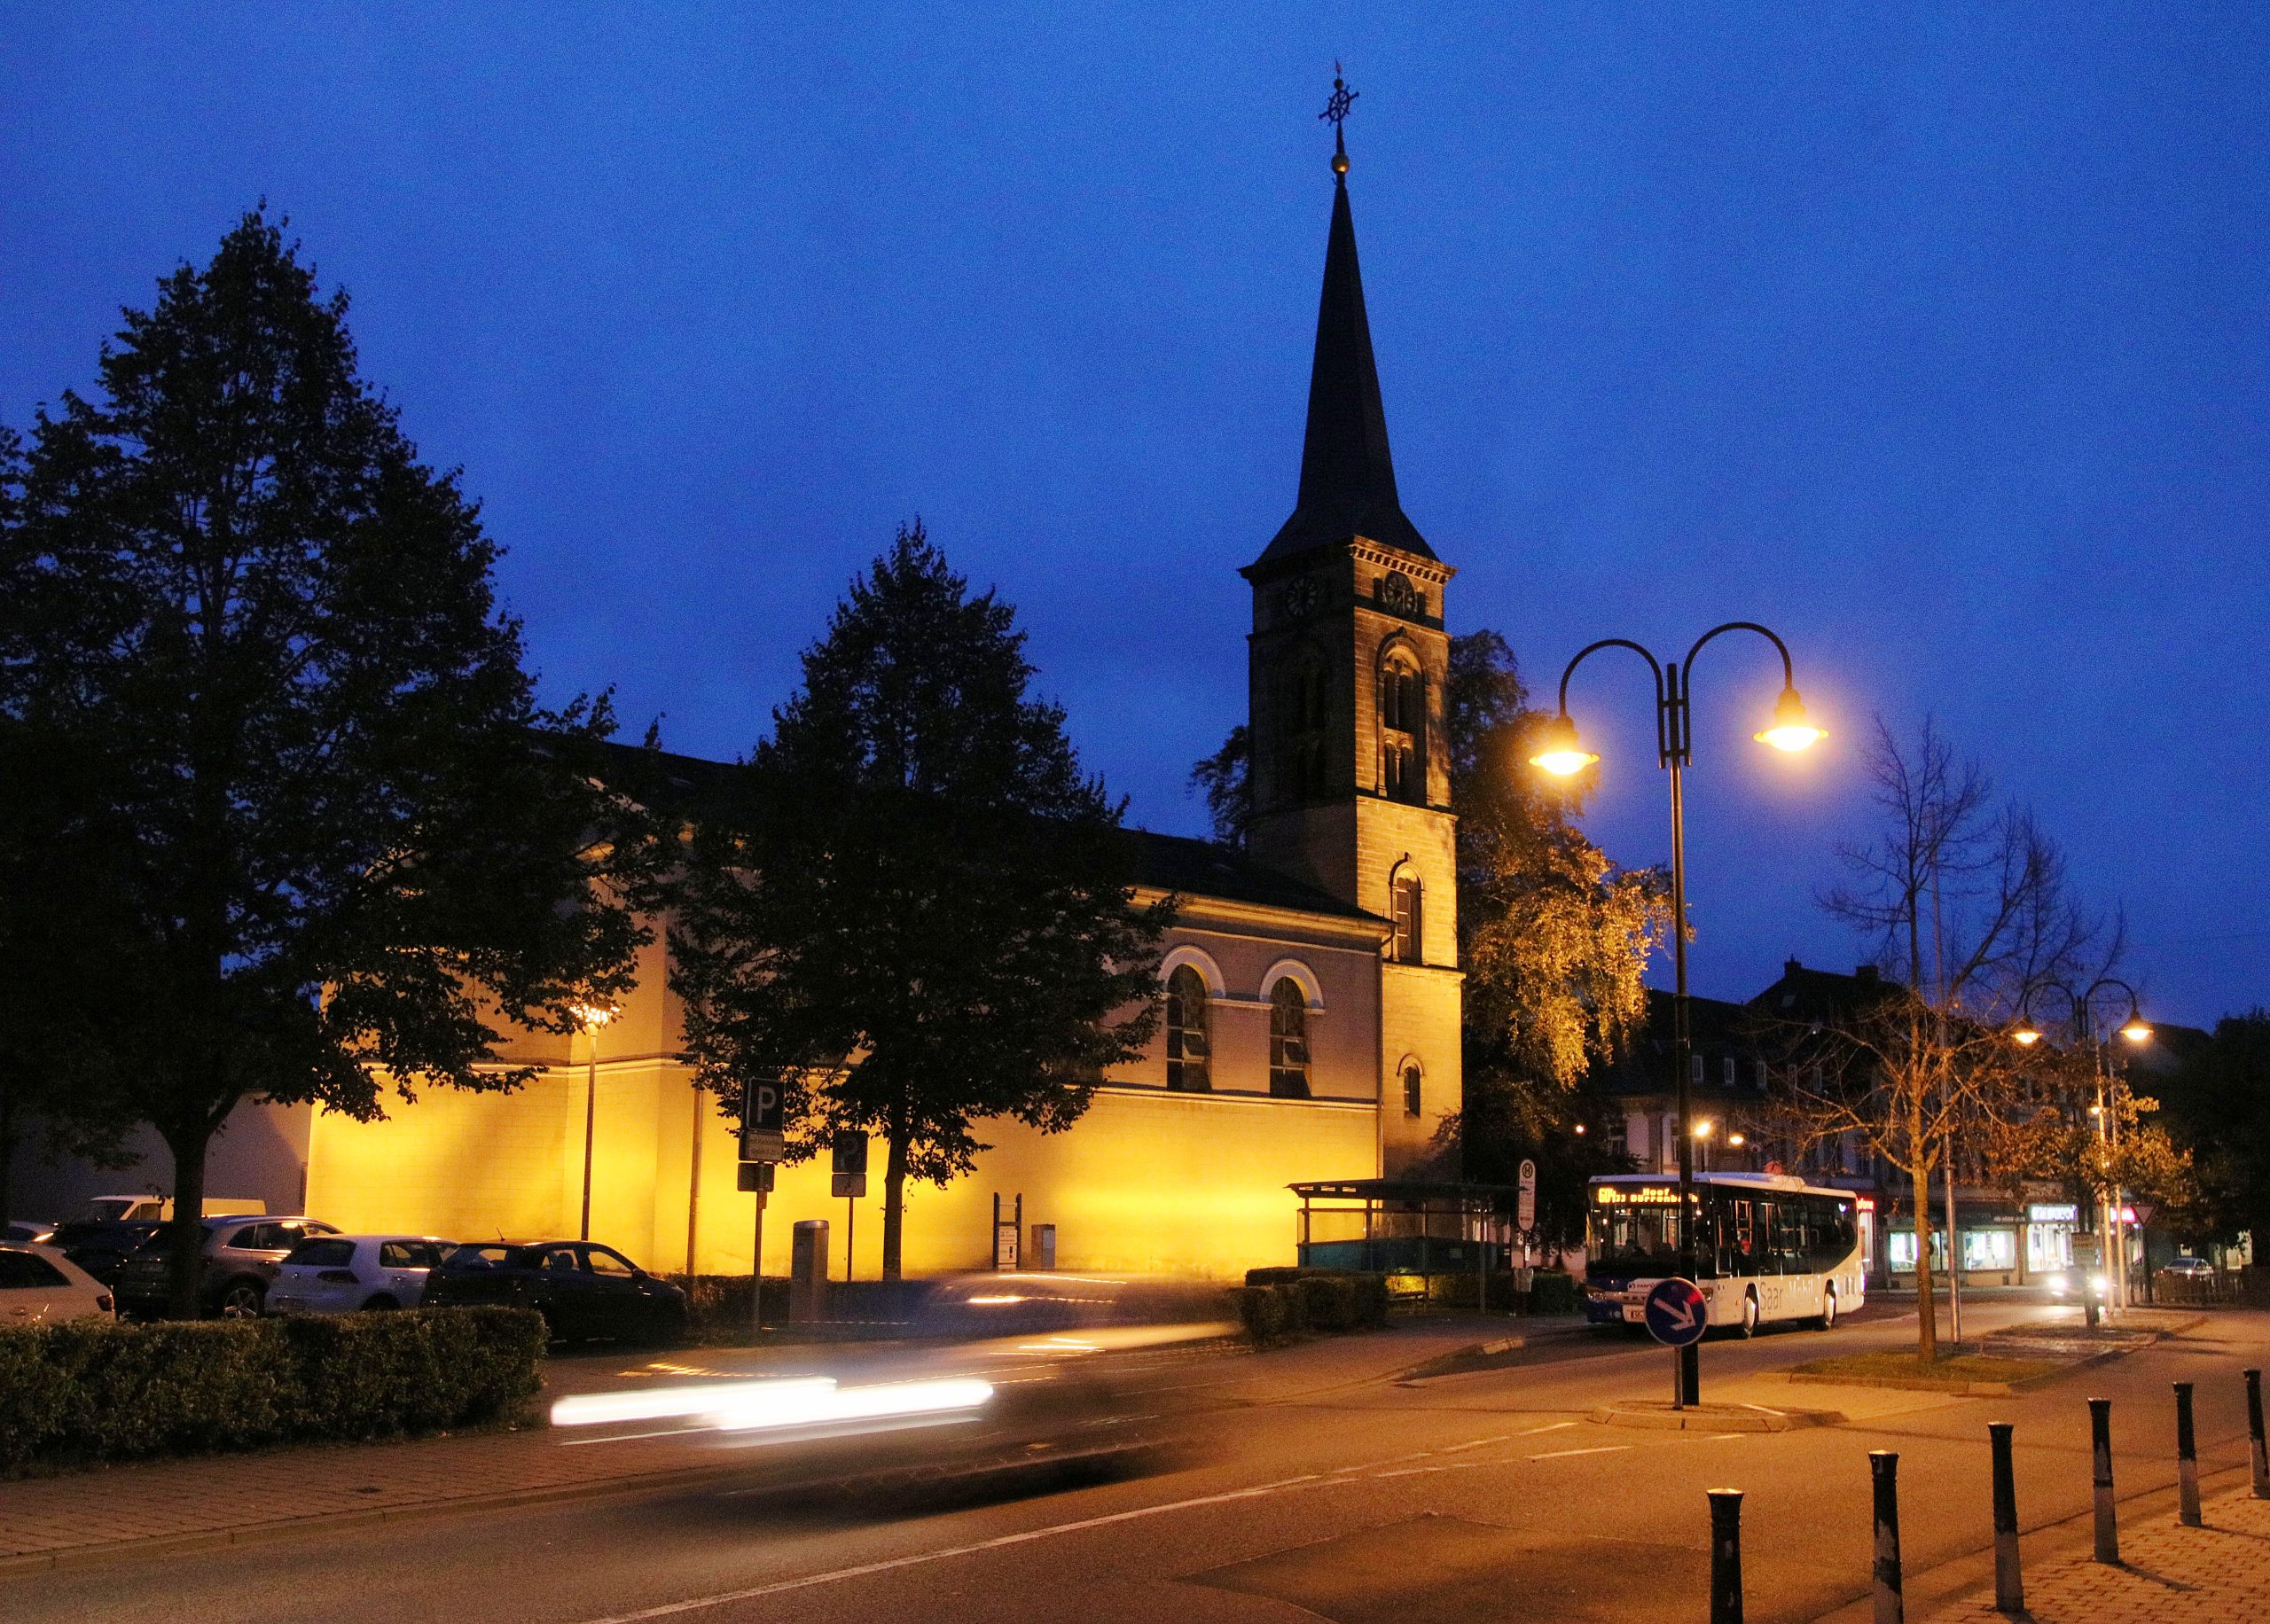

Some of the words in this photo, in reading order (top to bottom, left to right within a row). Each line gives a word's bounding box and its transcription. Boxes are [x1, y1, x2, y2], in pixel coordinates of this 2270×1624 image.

[756, 1086, 777, 1124] P
[1630, 1194, 1698, 1203] Dörrenbh
[1759, 1282, 1783, 1310] Saar
